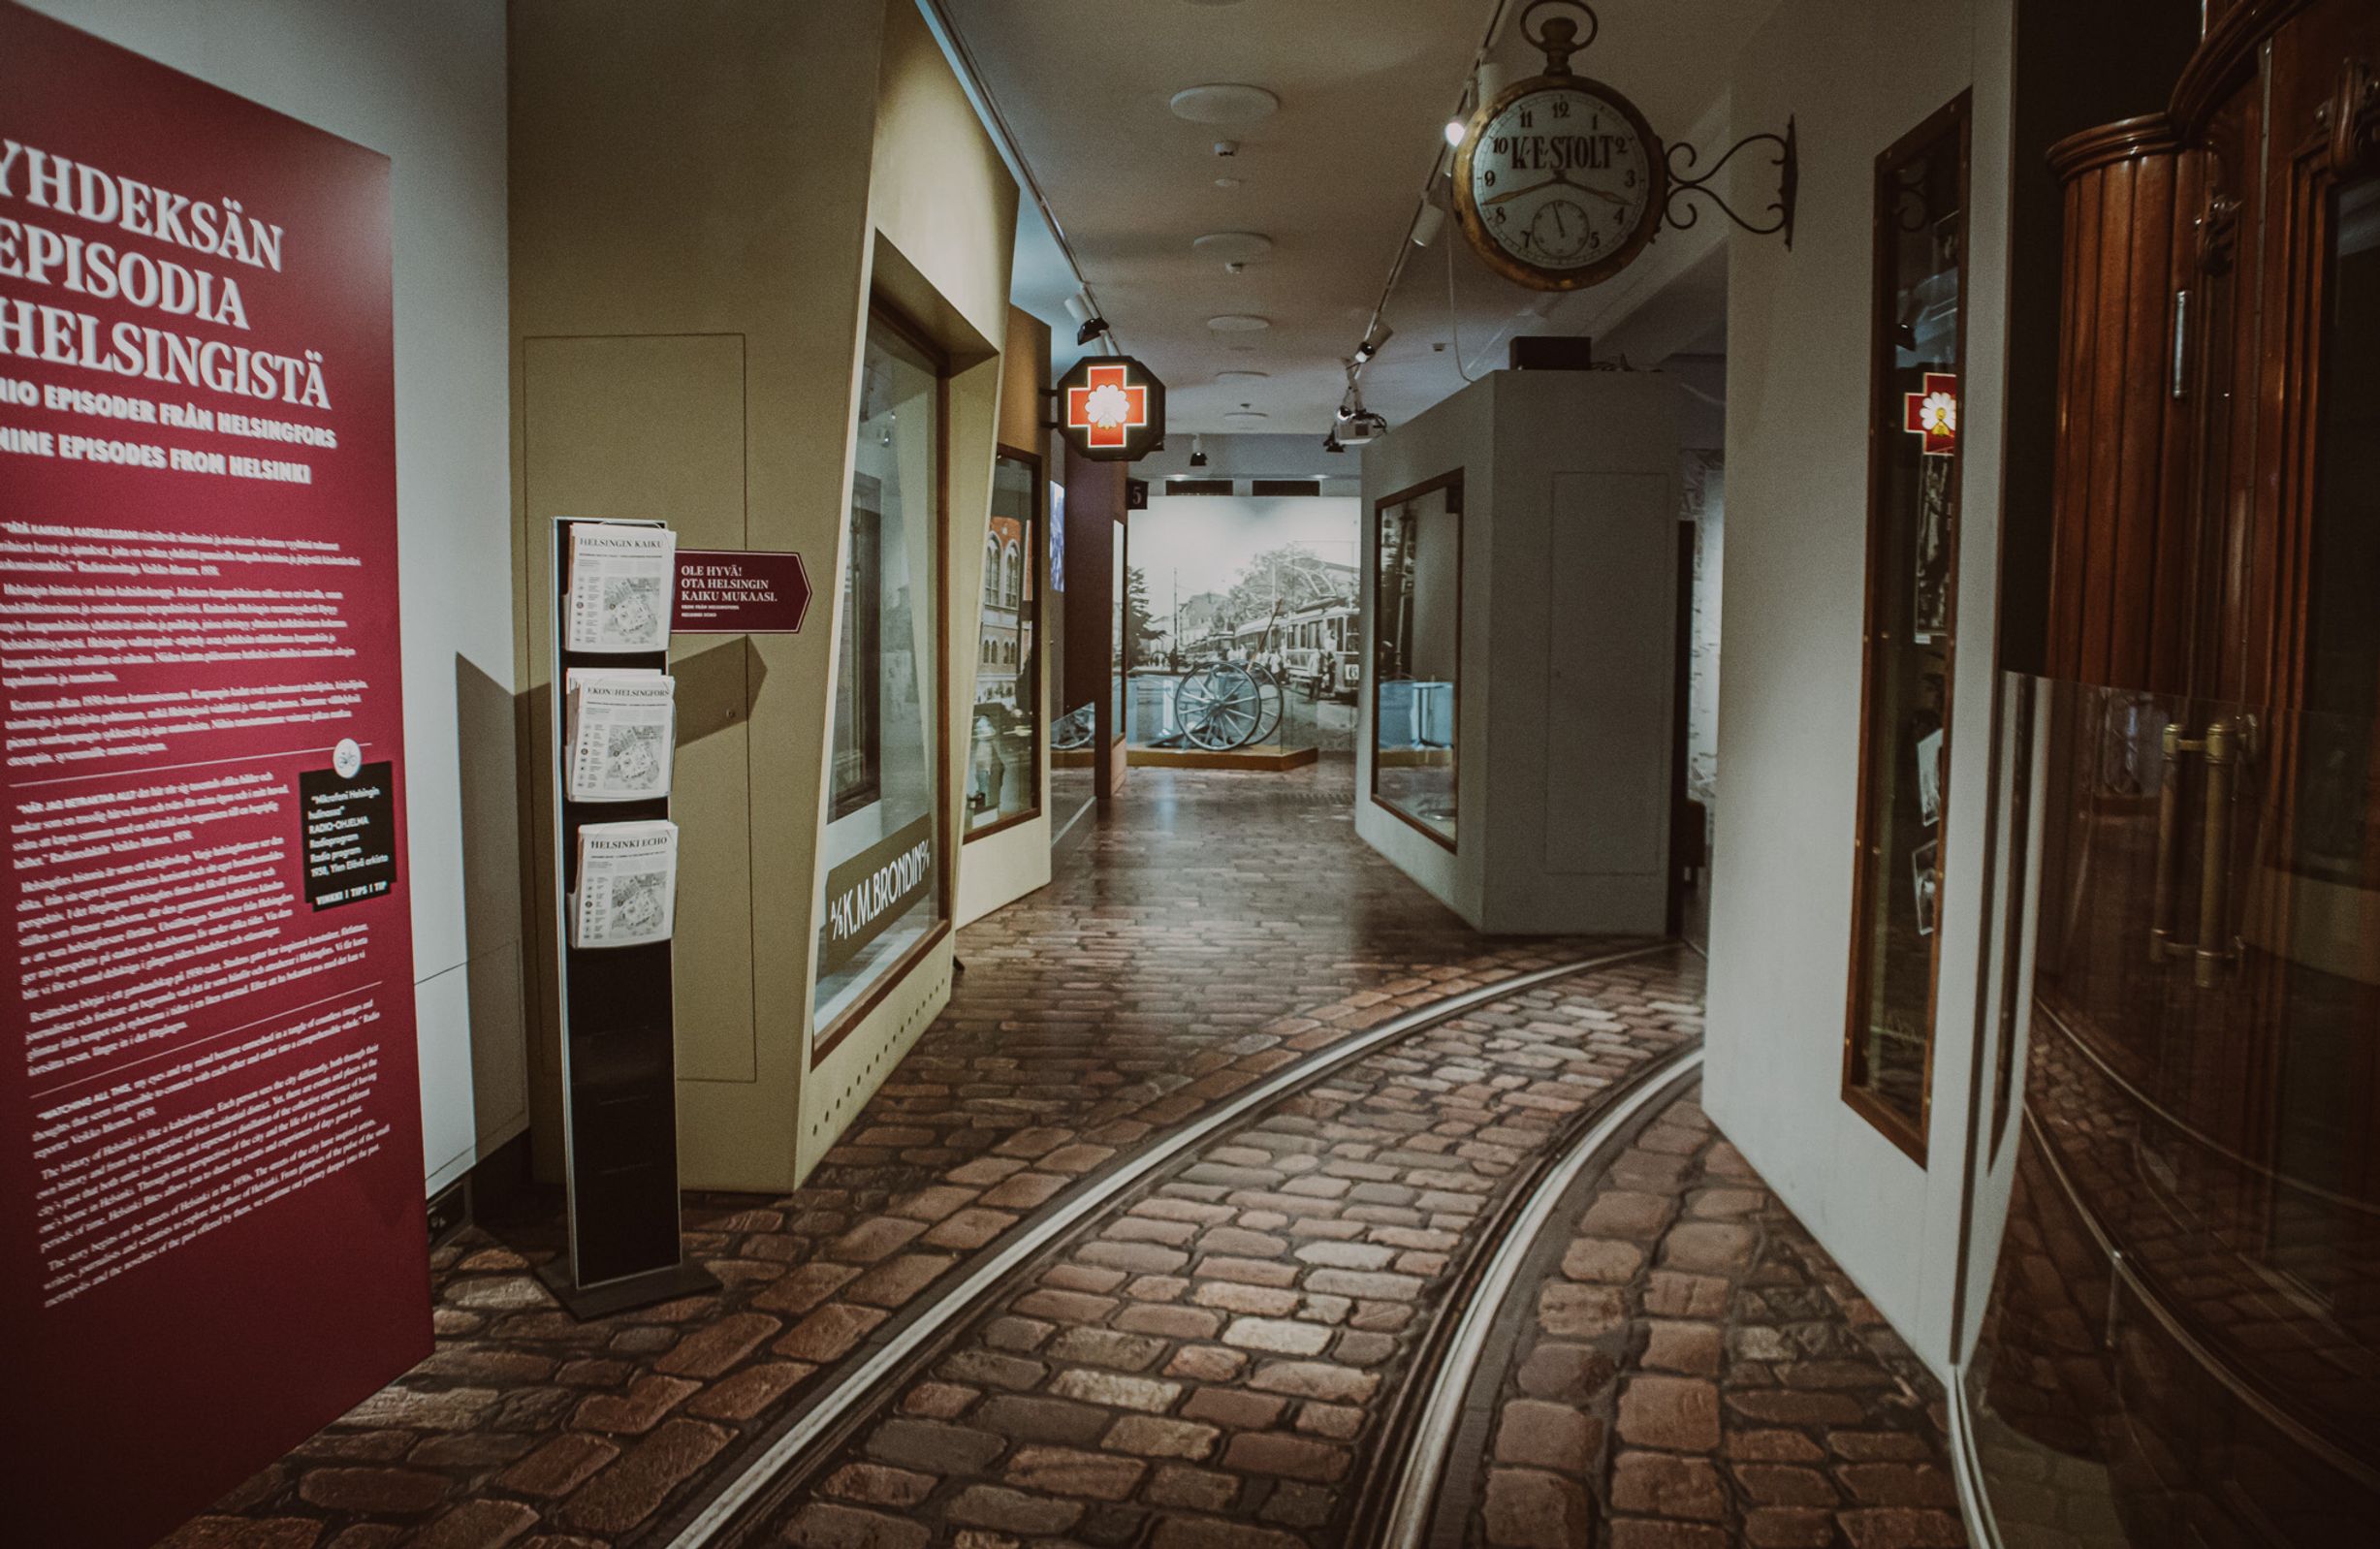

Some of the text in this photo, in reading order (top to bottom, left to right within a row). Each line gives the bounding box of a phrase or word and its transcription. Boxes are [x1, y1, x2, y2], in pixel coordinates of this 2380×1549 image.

[1553, 101, 1571, 118] 12
[1520, 111, 1533, 128] 11
[1592, 113, 1599, 130] 1
[1493, 138, 1508, 154] 10
[1615, 138, 1628, 154] 2
[1484, 170, 1496, 187] 9
[1625, 170, 1635, 187] 3
[0, 138, 284, 273] YHDEKSÄN
[1496, 206, 1507, 224] 8
[1613, 206, 1625, 225] 4
[1521, 231, 1531, 249] 7
[1590, 232, 1601, 249] 5
[0, 219, 251, 332] EPISODIA
[0, 296, 332, 410] HELSINGISTÄ
[44, 385, 158, 424] EPISODER
[159, 401, 214, 432] FRÅN
[217, 412, 338, 450] HELSINGFORS
[58, 434, 168, 470] EPISODES
[170, 447, 227, 475] FROM
[229, 457, 311, 485] HELSINKI
[1132, 486, 1142, 505] 5
[580, 537, 663, 549] HELSINGIN KAIKU
[681, 564, 743, 577] OLE HYVÄ!
[681, 578, 769, 589] OTA HELSINGIN
[682, 590, 778, 602] KAIKU MUKAASI.
[1349, 666, 1357, 679] 6
[590, 837, 667, 850] HELSINKI ECHO
[350, 885, 368, 898] TIPS
[373, 880, 388, 893] TIP
